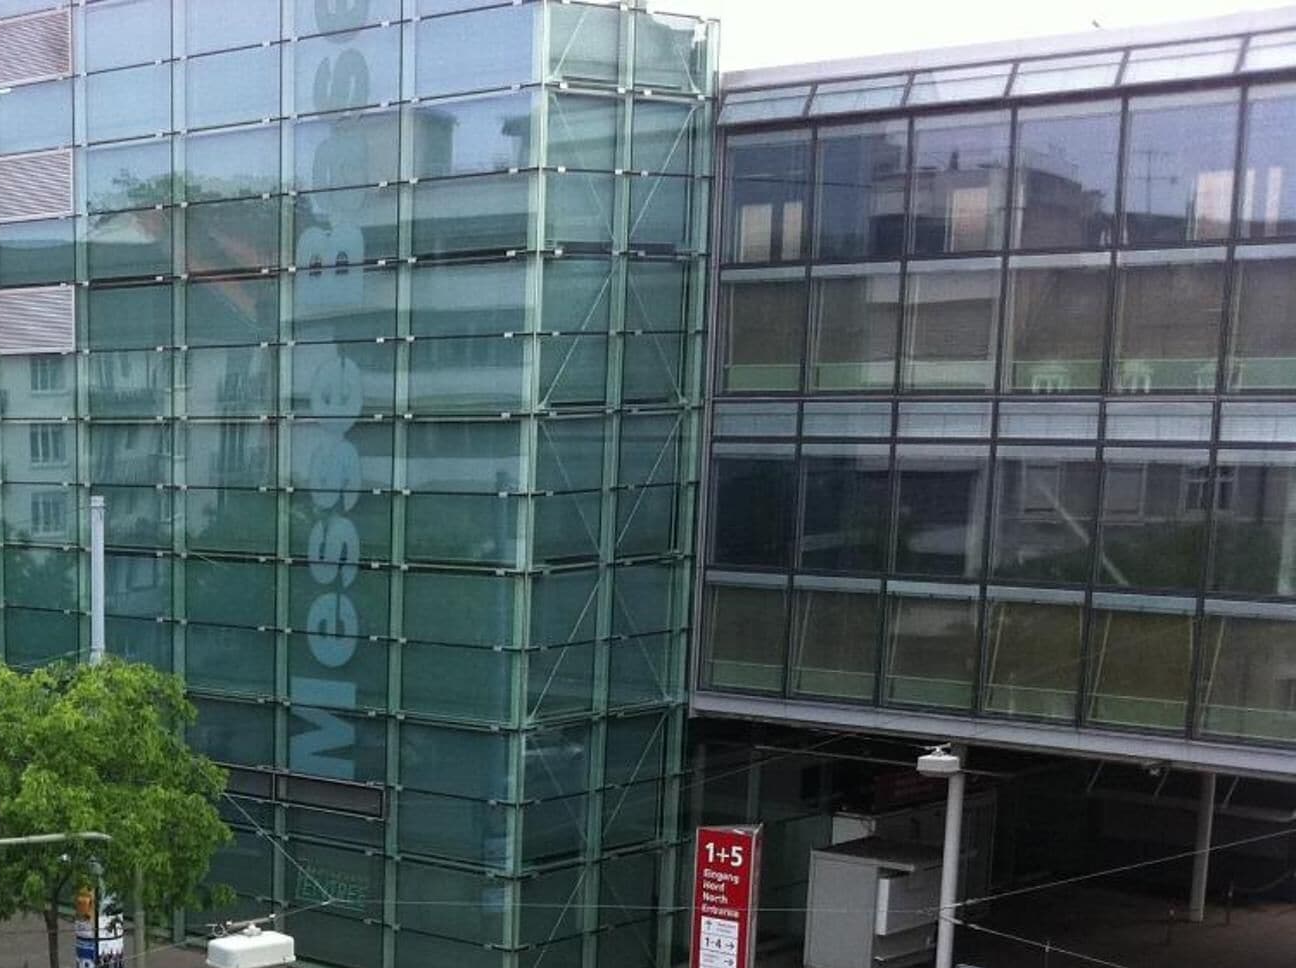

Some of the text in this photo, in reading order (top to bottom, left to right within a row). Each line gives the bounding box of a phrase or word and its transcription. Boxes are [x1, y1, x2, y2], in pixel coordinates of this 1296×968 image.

[289, 355, 363, 779] Messe
[705, 842, 743, 867] 1+5
[704, 868, 740, 885] Eingang
[703, 879, 725, 893] Nord
[703, 891, 728, 905] North
